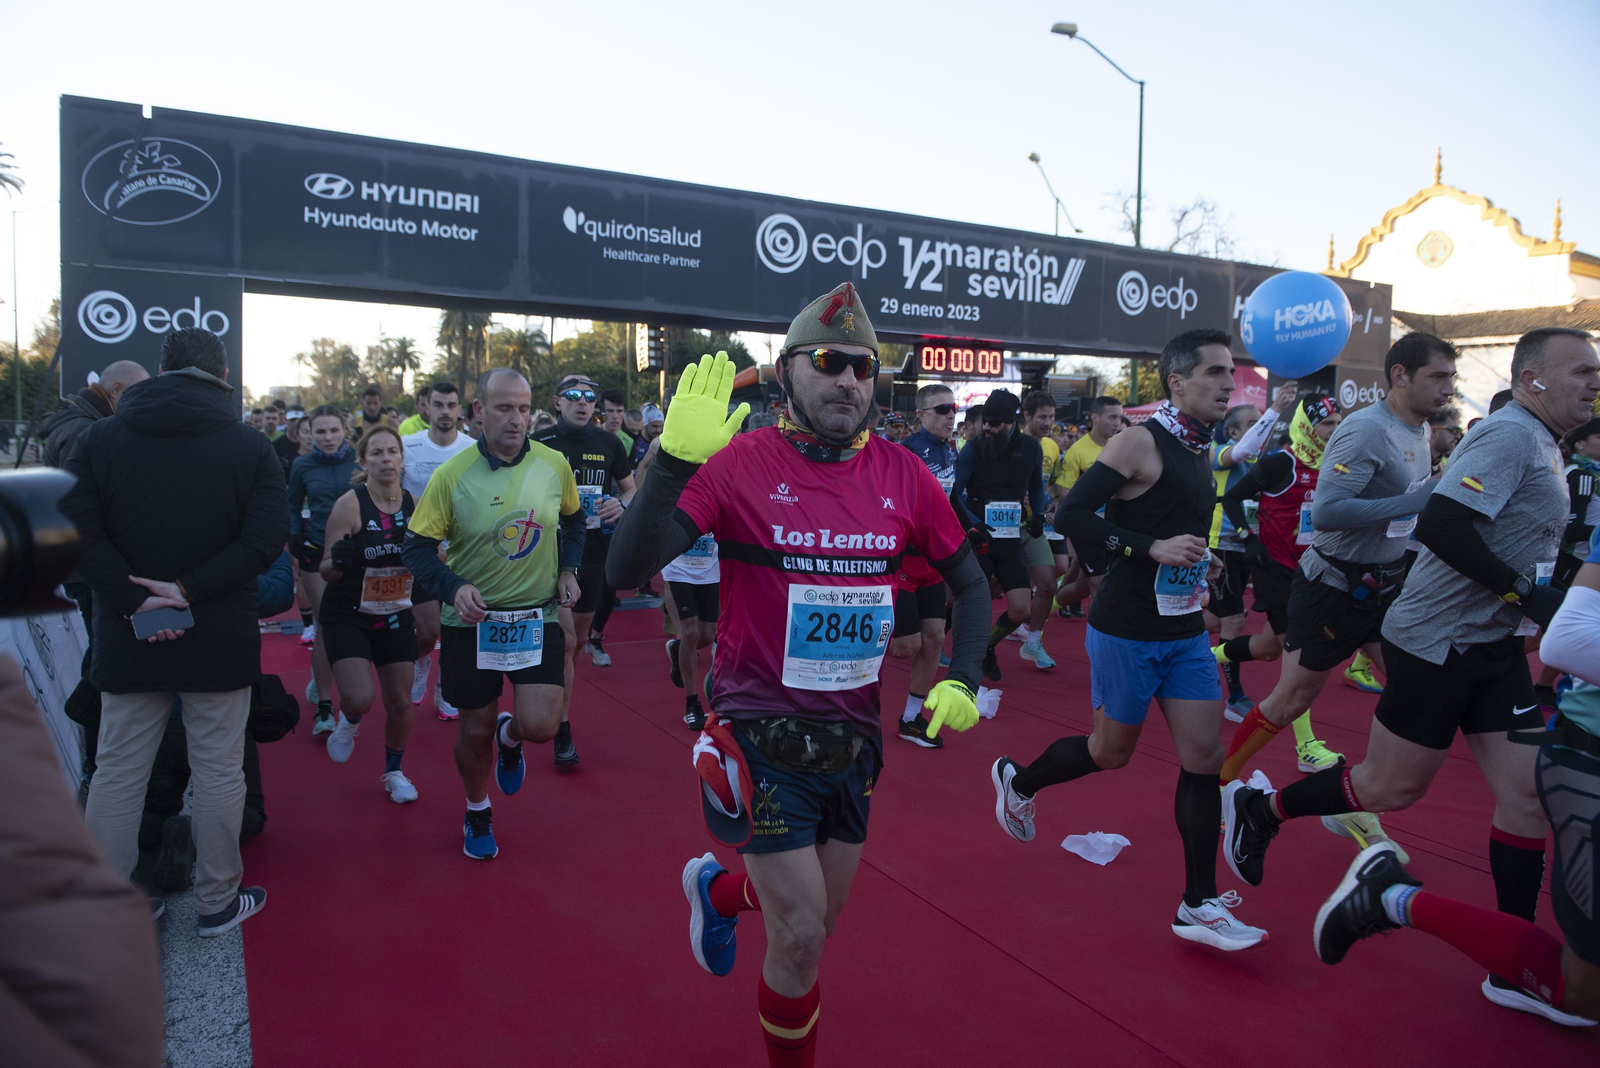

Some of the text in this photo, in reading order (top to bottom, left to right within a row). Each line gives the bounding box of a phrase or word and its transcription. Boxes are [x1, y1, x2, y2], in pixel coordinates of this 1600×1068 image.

[146, 175, 158, 186] de
[159, 173, 197, 192] Canarias
[361, 181, 480, 214] HYUNDAI
[304, 206, 479, 241] Hyundauto Motor
[603, 246, 701, 269] Healthcare Partner
[812, 223, 887, 279] edp
[935, 241, 1059, 278] maratón
[967, 270, 1060, 305] sevilla
[1151, 277, 1198, 320] edp
[880, 297, 981, 322] 29 enero 2023
[1274, 299, 1336, 331] HOKA
[1275, 322, 1337, 343] FLY HUMAN FLY
[582, 453, 605, 461] ROBER
[992, 511, 1014, 521] 3014
[772, 525, 897, 550] Los Lentos
[783, 556, 887, 574] CLUB DE ATLETISMO
[819, 591, 839, 603] edp
[853, 591, 880, 599] maratón
[489, 624, 527, 644] 2827
[806, 612, 873, 643] 2846
[841, 661, 857, 672] edp
[765, 827, 789, 835] EDICIÓN
